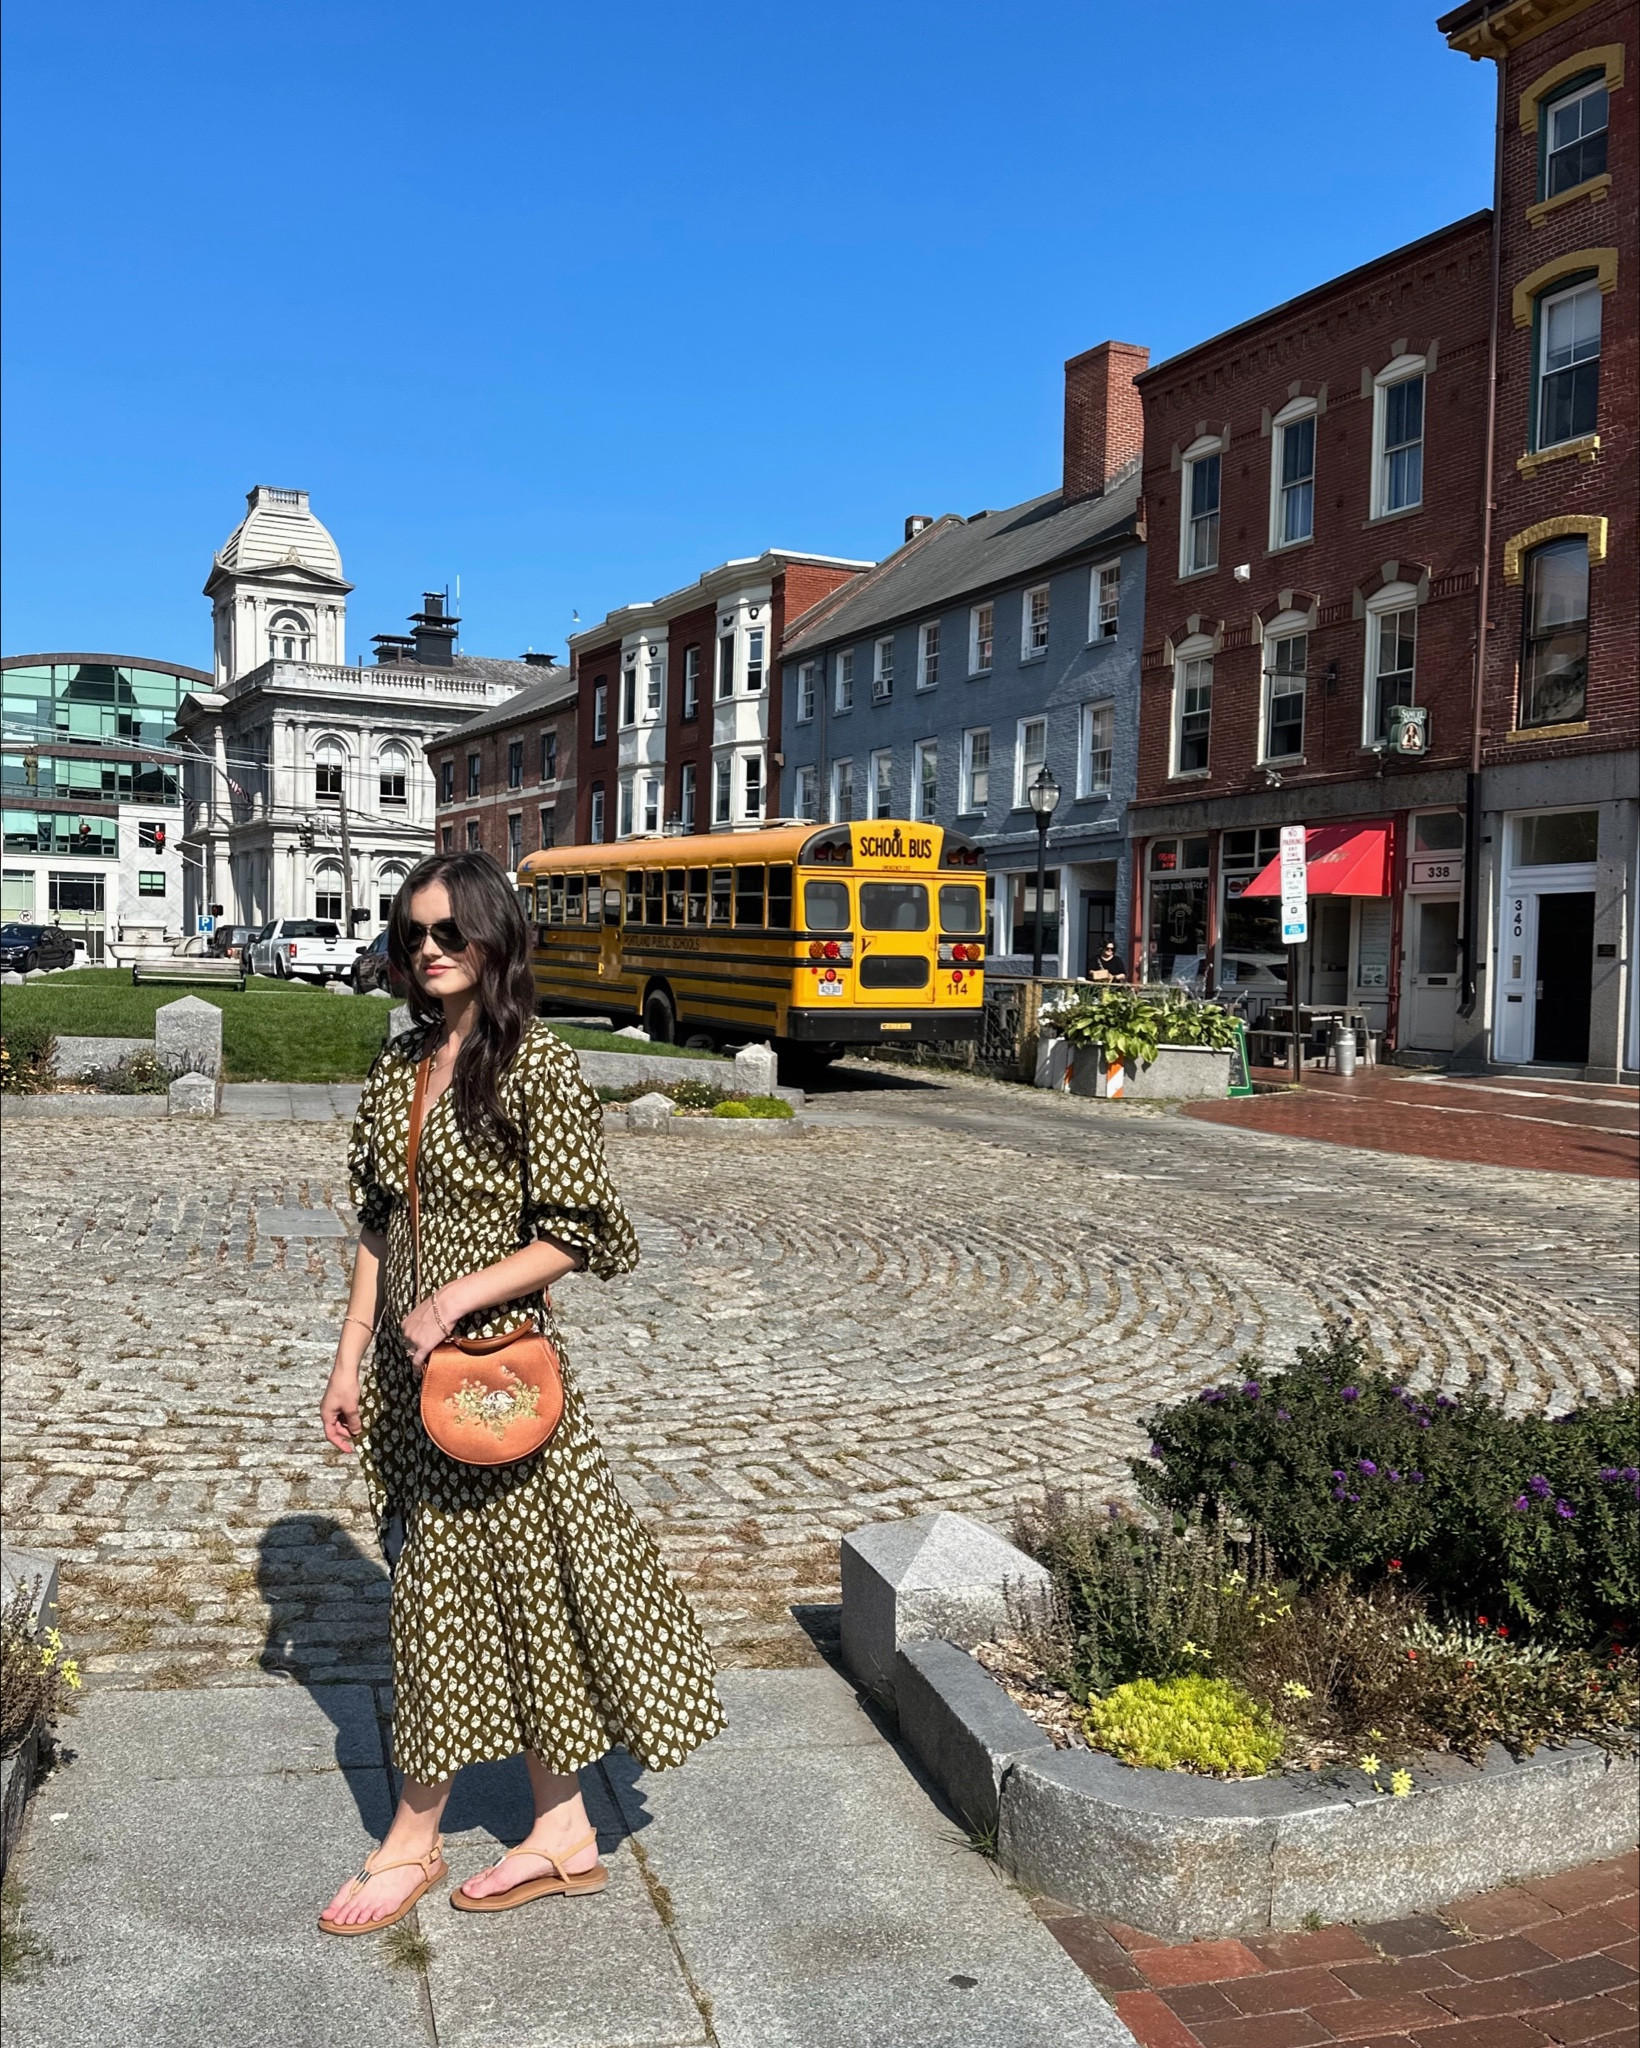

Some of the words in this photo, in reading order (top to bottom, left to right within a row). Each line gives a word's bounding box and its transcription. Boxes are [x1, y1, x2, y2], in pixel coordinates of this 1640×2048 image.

[860, 837, 906, 858] SCHOOL
[909, 839, 932, 859] BUS
[1428, 866, 1450, 878] 338
[202, 917, 210, 927] P
[1513, 900, 1523, 937] 340
[672, 937, 700, 951] SCHOOLS
[946, 983, 968, 995] 114
